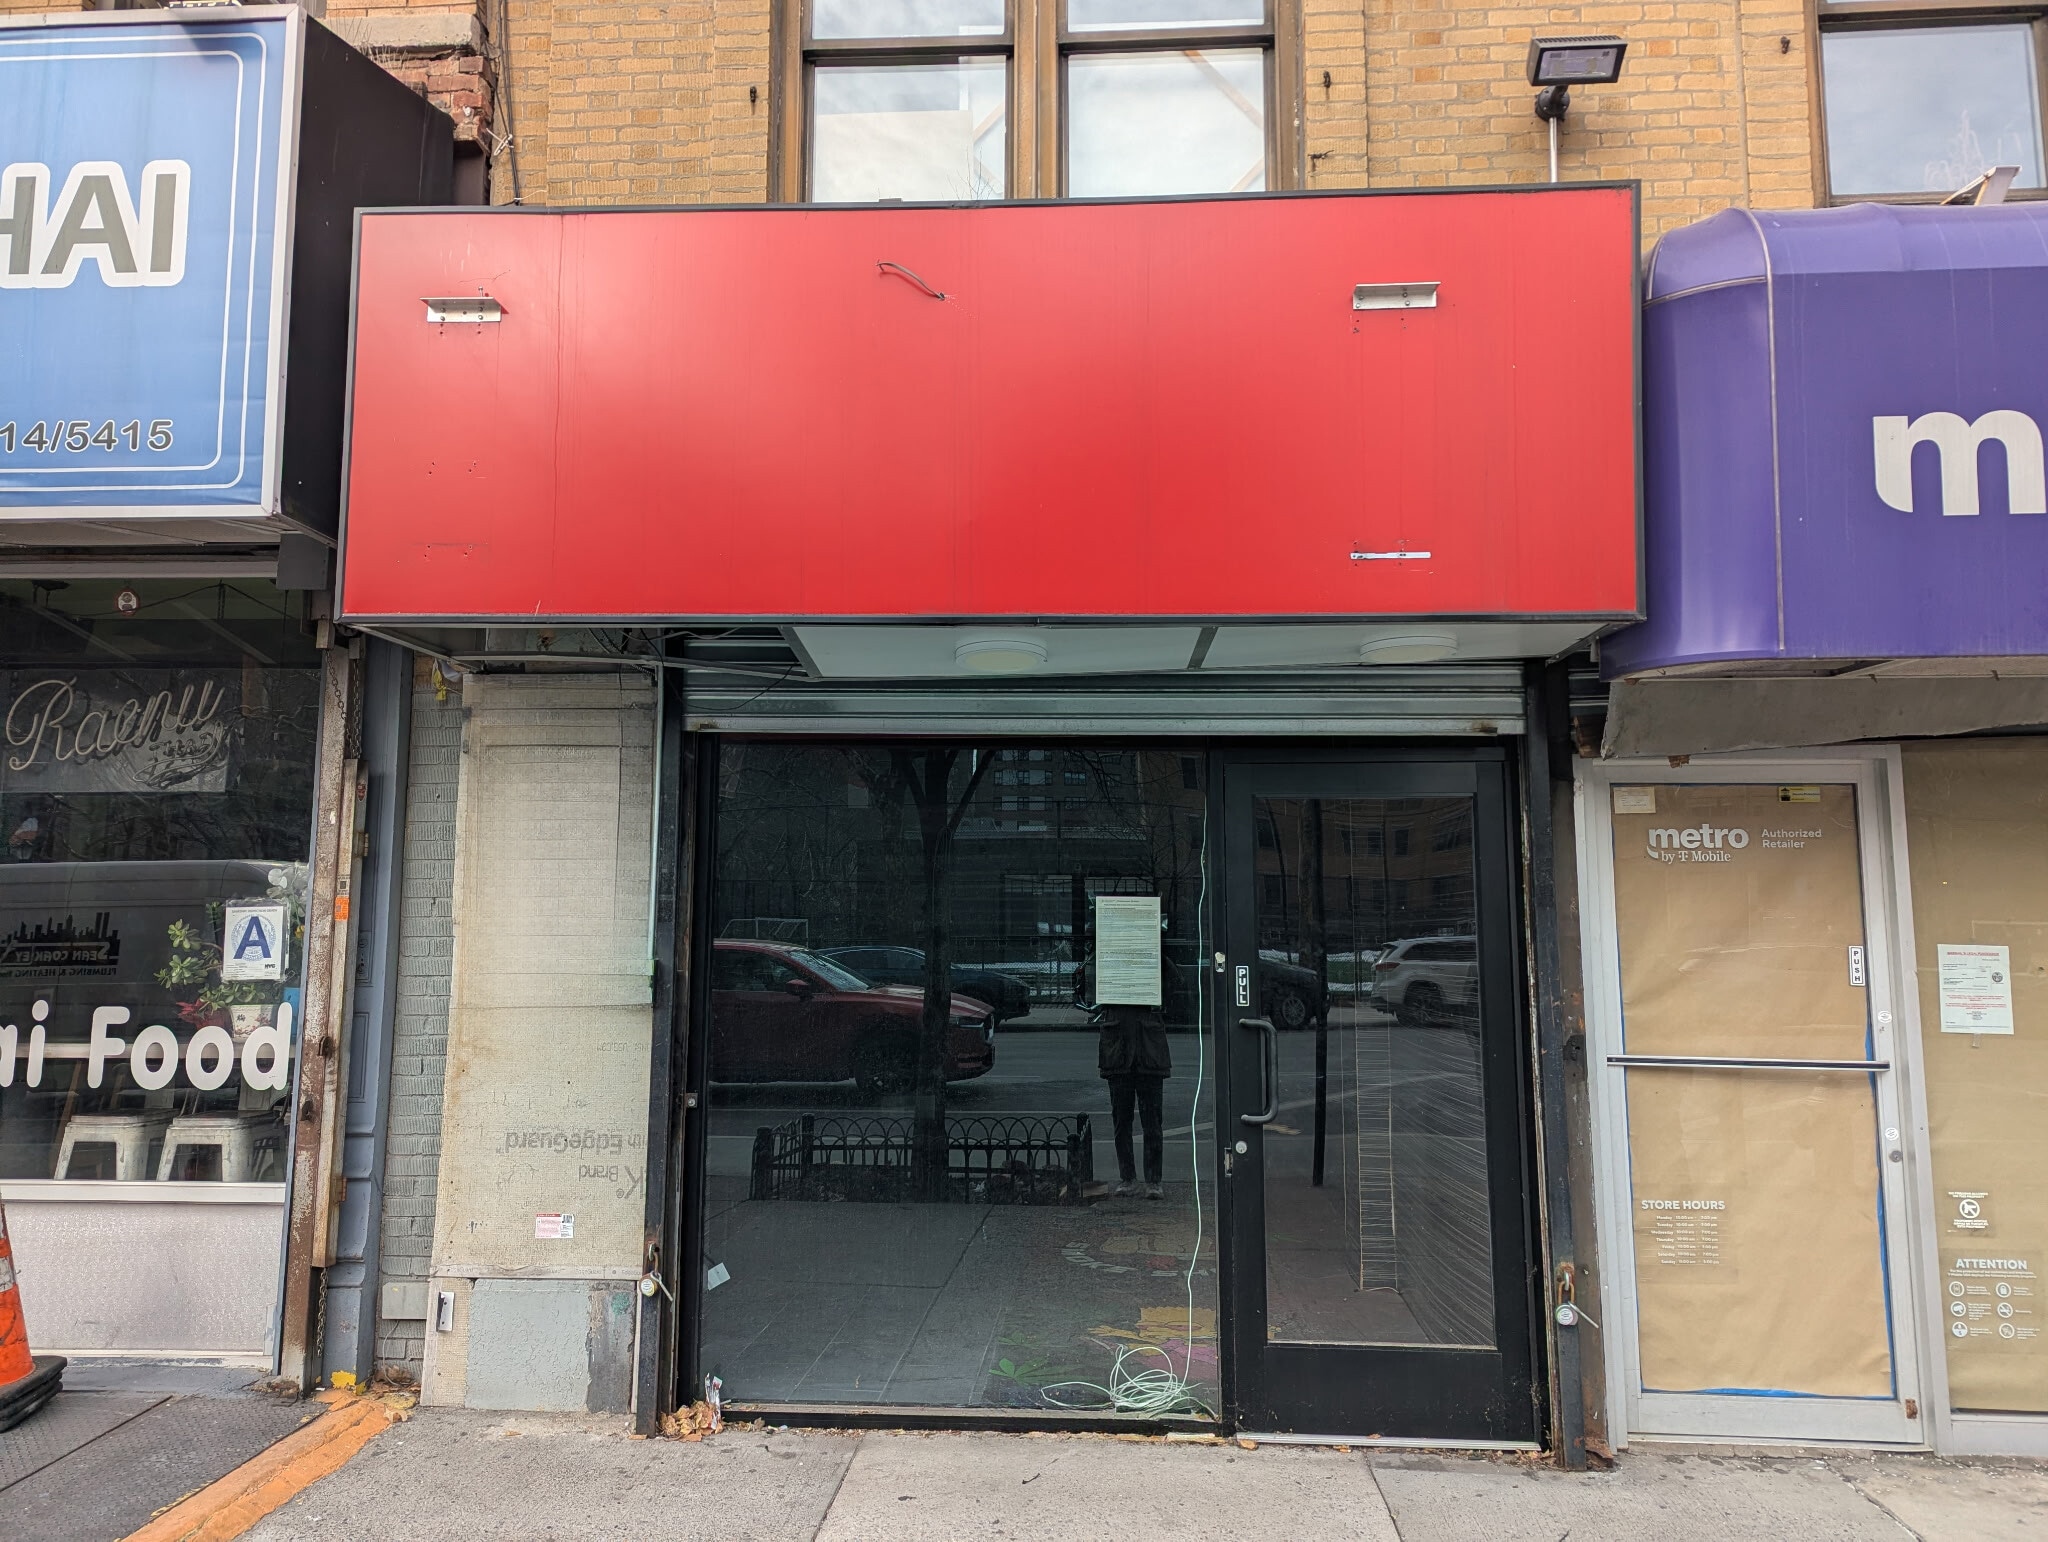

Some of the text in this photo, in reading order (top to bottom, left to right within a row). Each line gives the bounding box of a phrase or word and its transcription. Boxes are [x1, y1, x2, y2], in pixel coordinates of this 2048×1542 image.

[1648, 824, 1749, 849] metro
[1761, 829, 1822, 838] Authorized
[1762, 840, 1805, 849] Retailer
[1661, 851, 1675, 864] by
[233, 916, 272, 959] A
[1853, 951, 1861, 981] PUSH
[1238, 968, 1247, 1004] PULL
[87, 1002, 292, 1090] Food
[579, 1165, 619, 1182] Brand
[1641, 1200, 1726, 1210] STORE HOURS
[1955, 1258, 2028, 1270] ATTENTION
